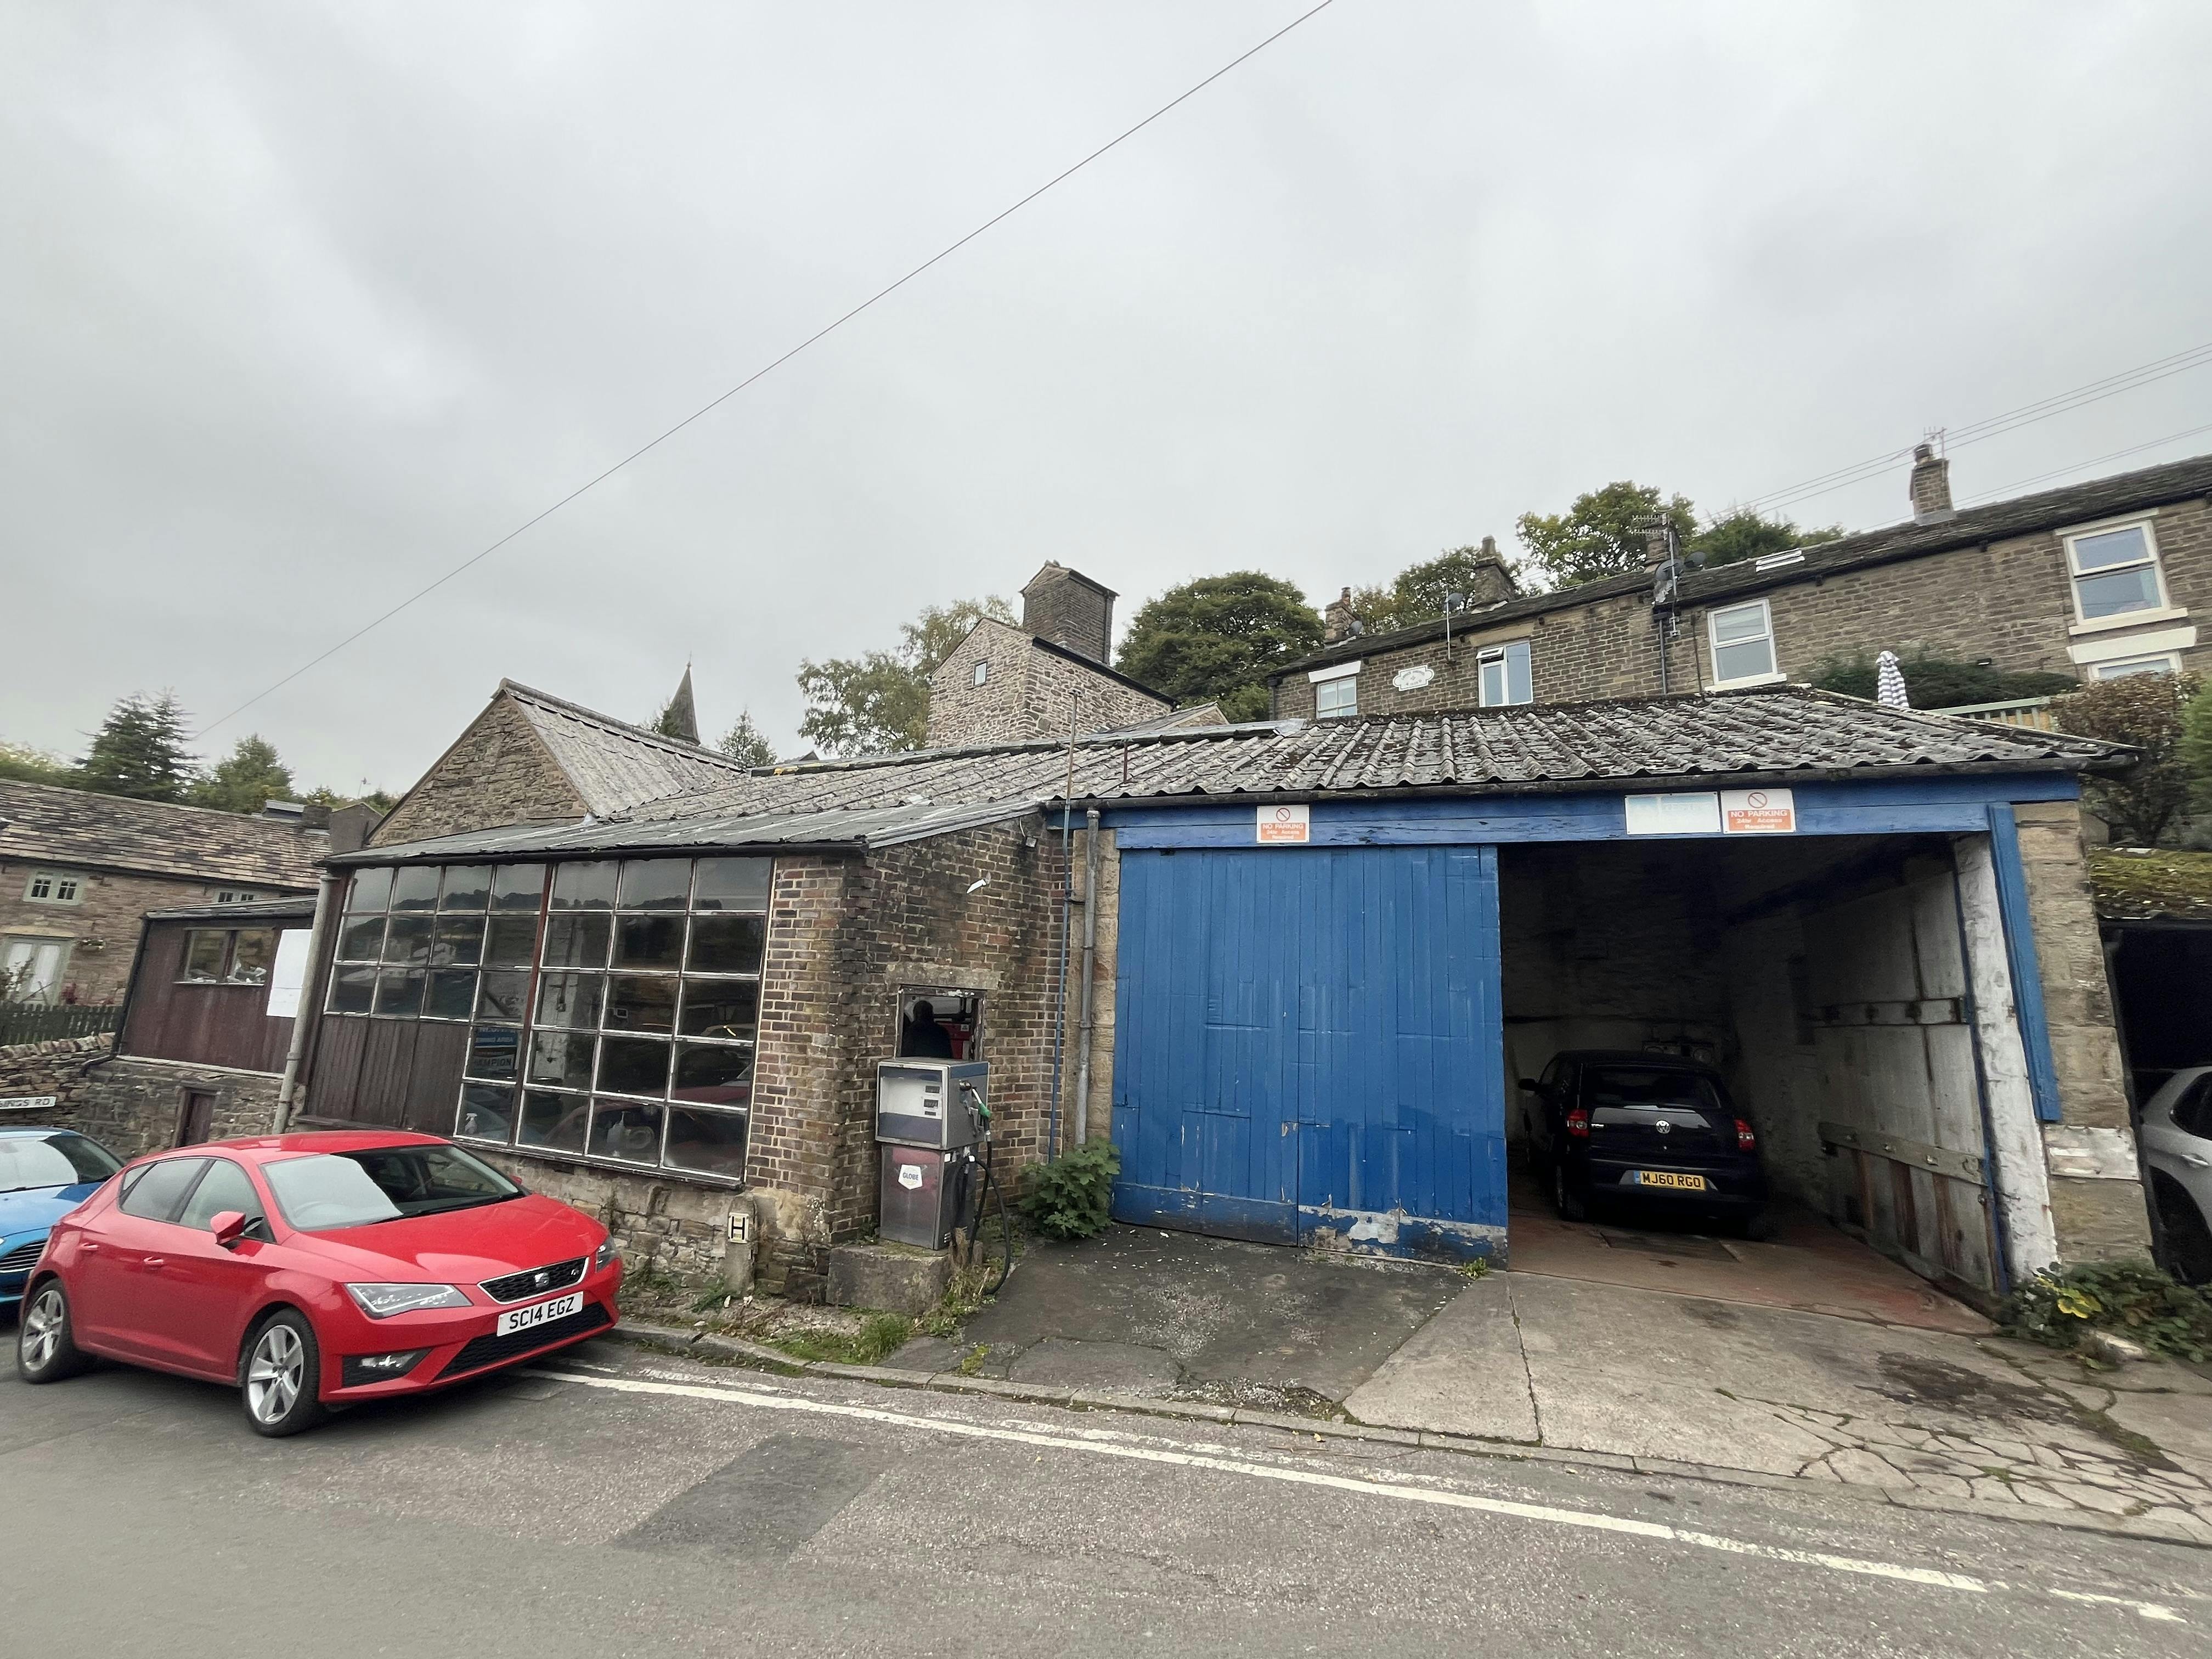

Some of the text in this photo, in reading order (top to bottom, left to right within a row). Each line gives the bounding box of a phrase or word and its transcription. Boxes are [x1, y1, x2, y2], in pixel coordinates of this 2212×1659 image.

[902, 1172, 919, 1181] GLOBE
[1643, 1172, 1701, 1187] MJ60 RGO
[731, 1216, 746, 1240] H
[509, 1296, 575, 1329] SC14 EGZ
